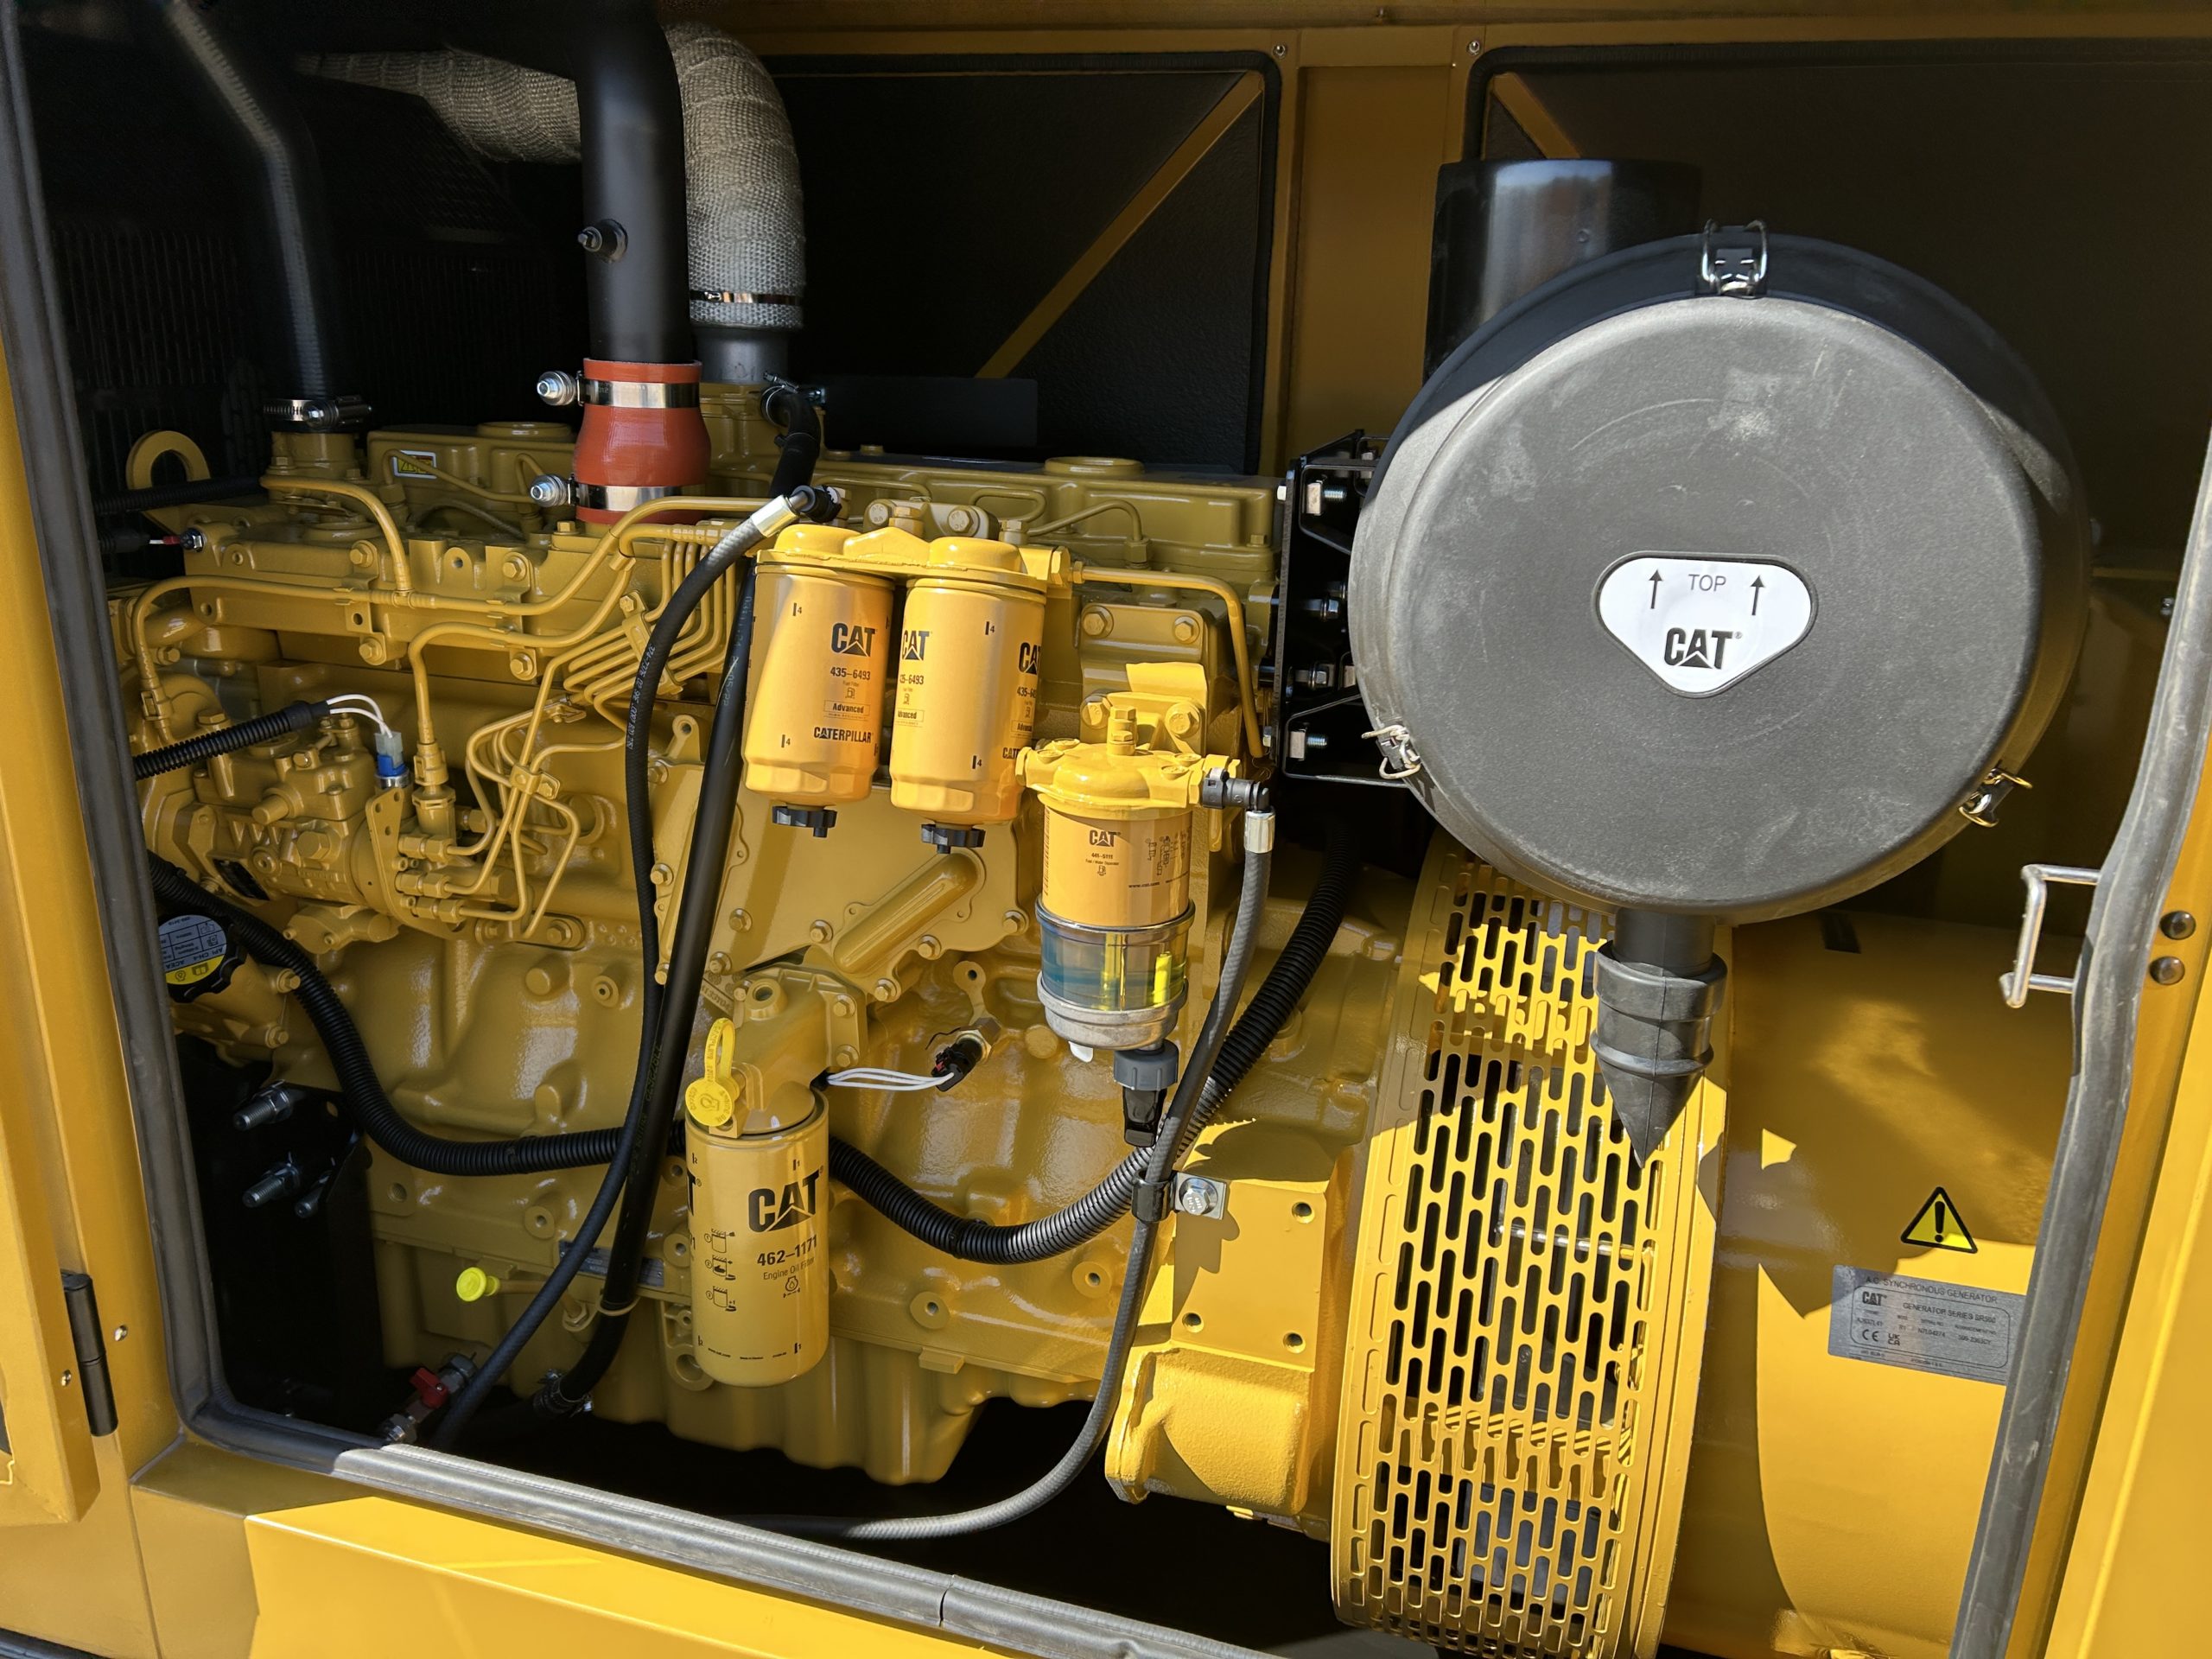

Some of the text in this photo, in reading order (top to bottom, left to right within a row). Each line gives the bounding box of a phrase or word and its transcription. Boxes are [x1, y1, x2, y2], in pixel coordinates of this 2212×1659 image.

[1688, 574, 1726, 592] TOP
[831, 622, 876, 657] CAT
[1664, 627, 1733, 670] CAT
[830, 666, 871, 681] 435-6493
[832, 702, 864, 714] Advanced
[813, 726, 872, 743] CATERPILLAR
[1090, 830, 1116, 847] CAT
[748, 1168, 819, 1233] CAT
[757, 1234, 817, 1267] 462-1171
[763, 1268, 788, 1281] Engine
[790, 1263, 800, 1274] Oil
[1862, 1291, 1882, 1306] CAT
[1884, 1279, 1945, 1295] SYNCHRONOUS
[1948, 1288, 1998, 1303] GENERATOR
[1903, 1302, 1946, 1315] GENERATOR
[1948, 1309, 1974, 1320] SERIES
